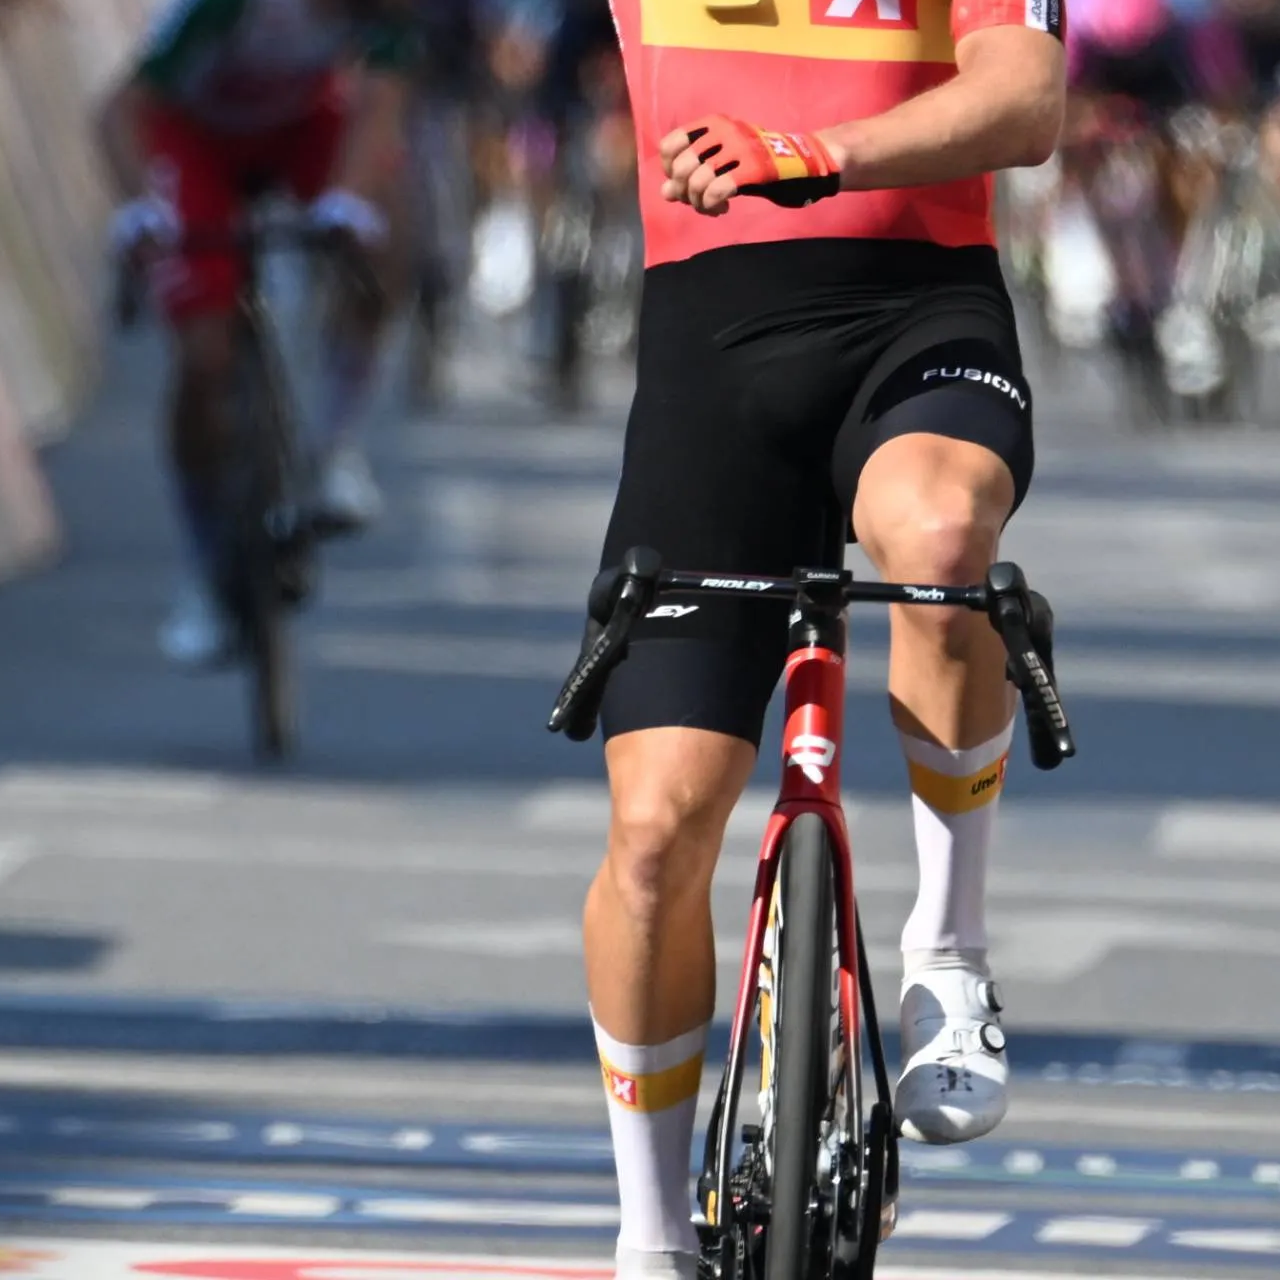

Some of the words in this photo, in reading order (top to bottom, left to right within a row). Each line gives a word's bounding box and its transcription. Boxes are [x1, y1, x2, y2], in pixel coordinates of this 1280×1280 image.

[923, 367, 1026, 410] FUSION
[701, 578, 774, 591] RIDLEY
[1022, 651, 1067, 729] SRAM
[971, 772, 999, 795] Uno
